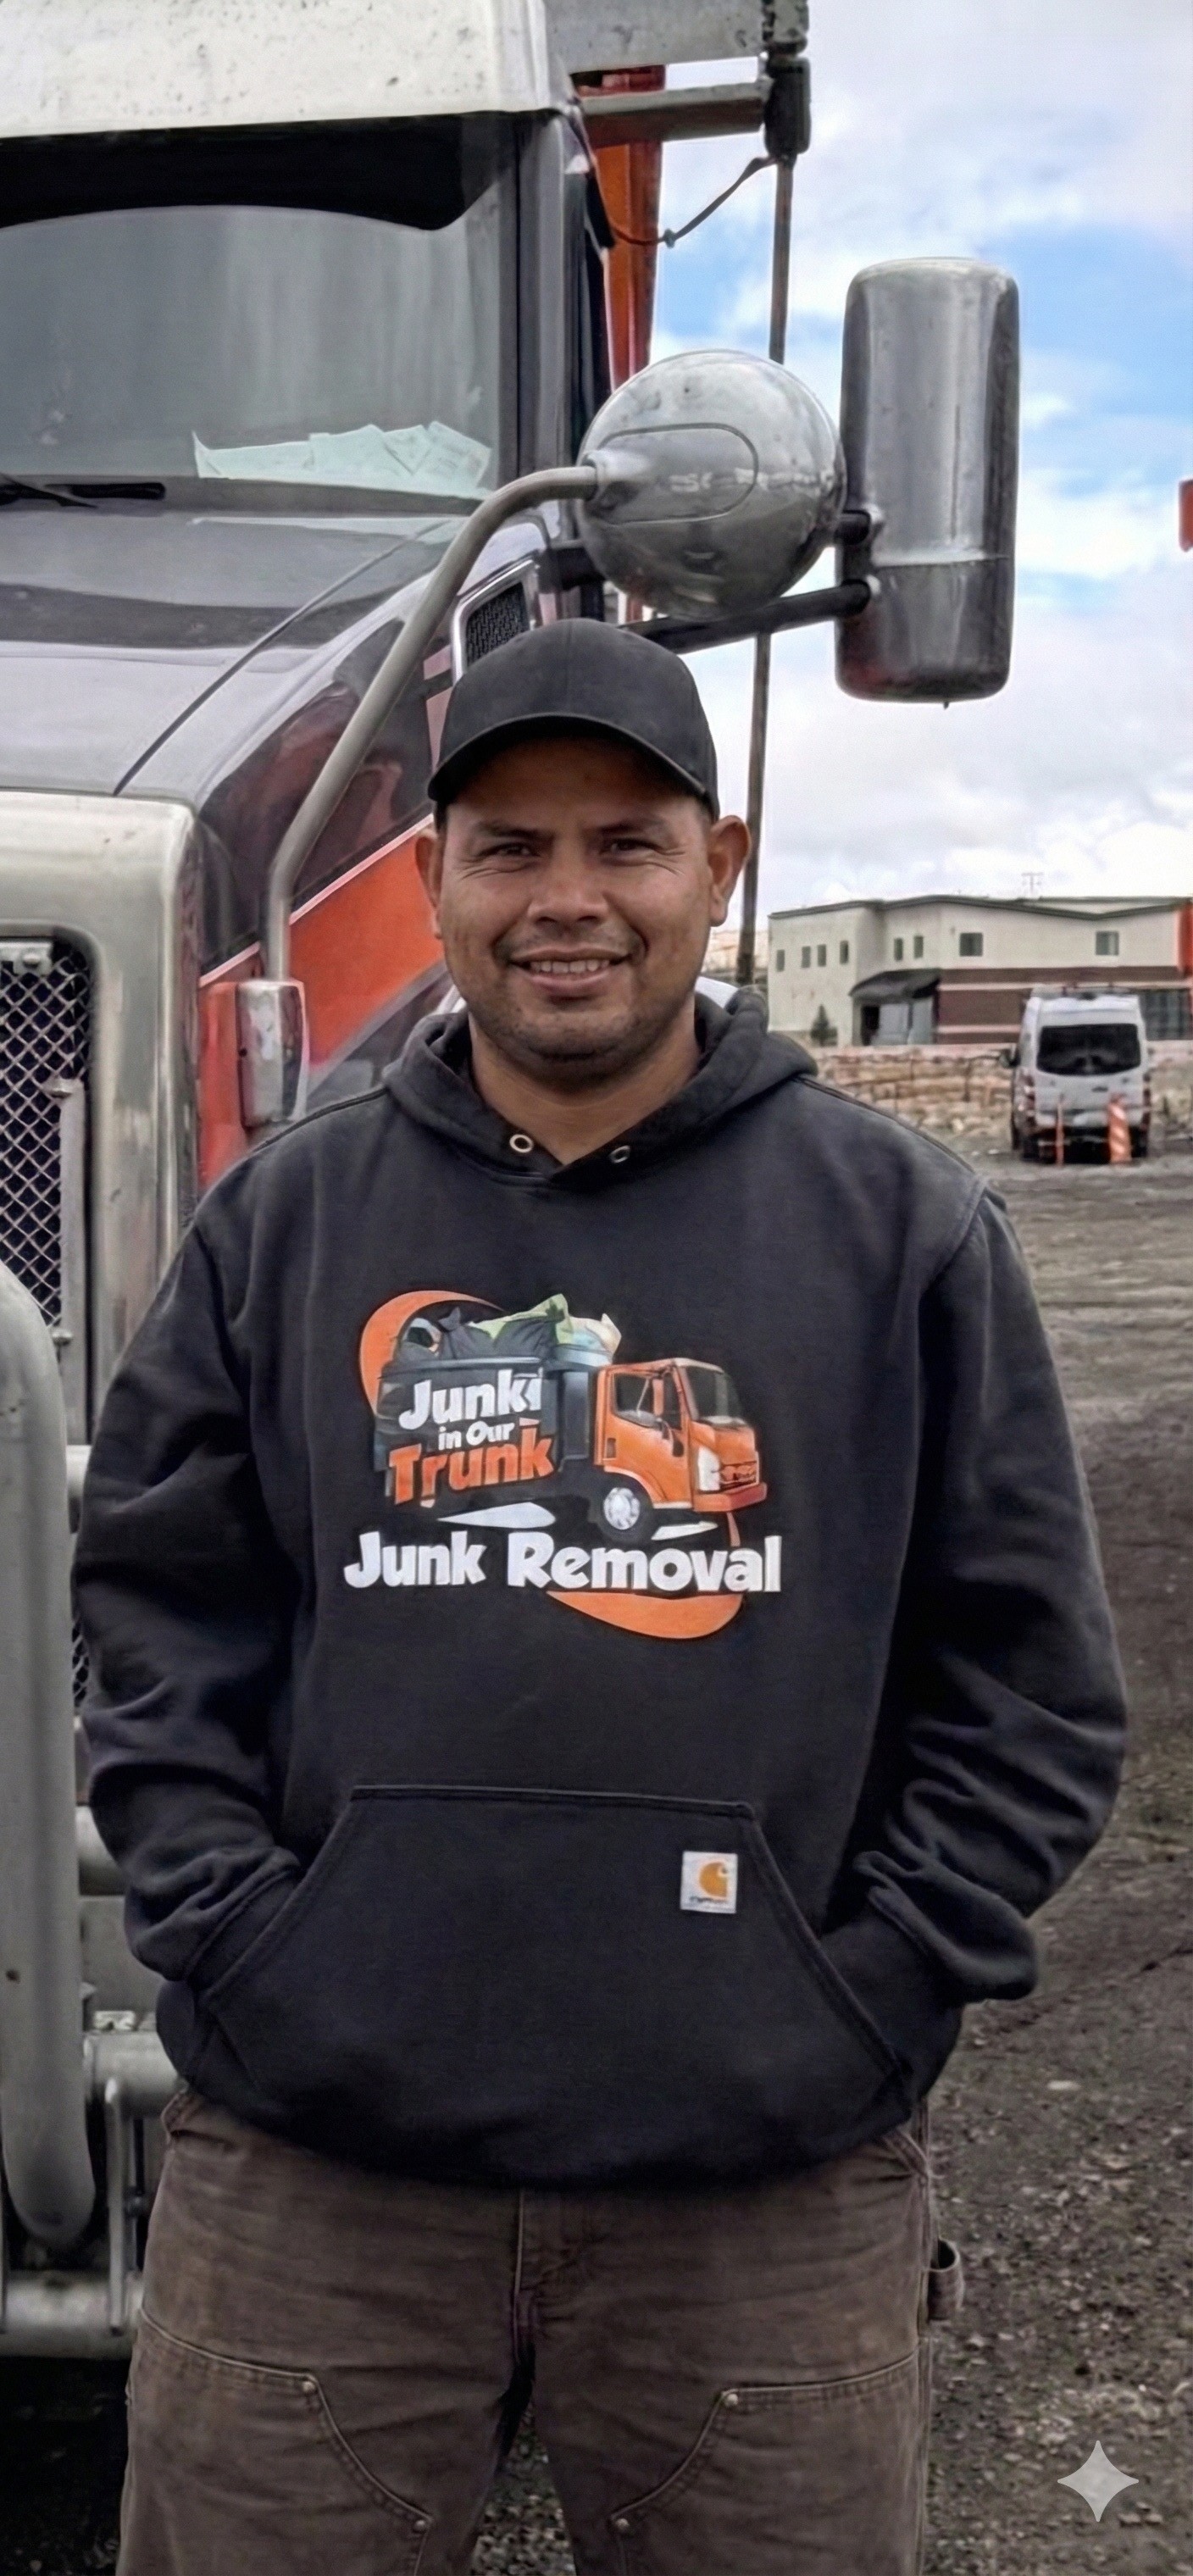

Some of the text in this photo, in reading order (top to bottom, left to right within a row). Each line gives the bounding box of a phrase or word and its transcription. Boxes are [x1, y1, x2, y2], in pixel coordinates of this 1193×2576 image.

[388, 1426, 555, 1506] Trunk
[437, 1420, 516, 1451] in Our
[343, 1530, 783, 1593] Junk Removal
